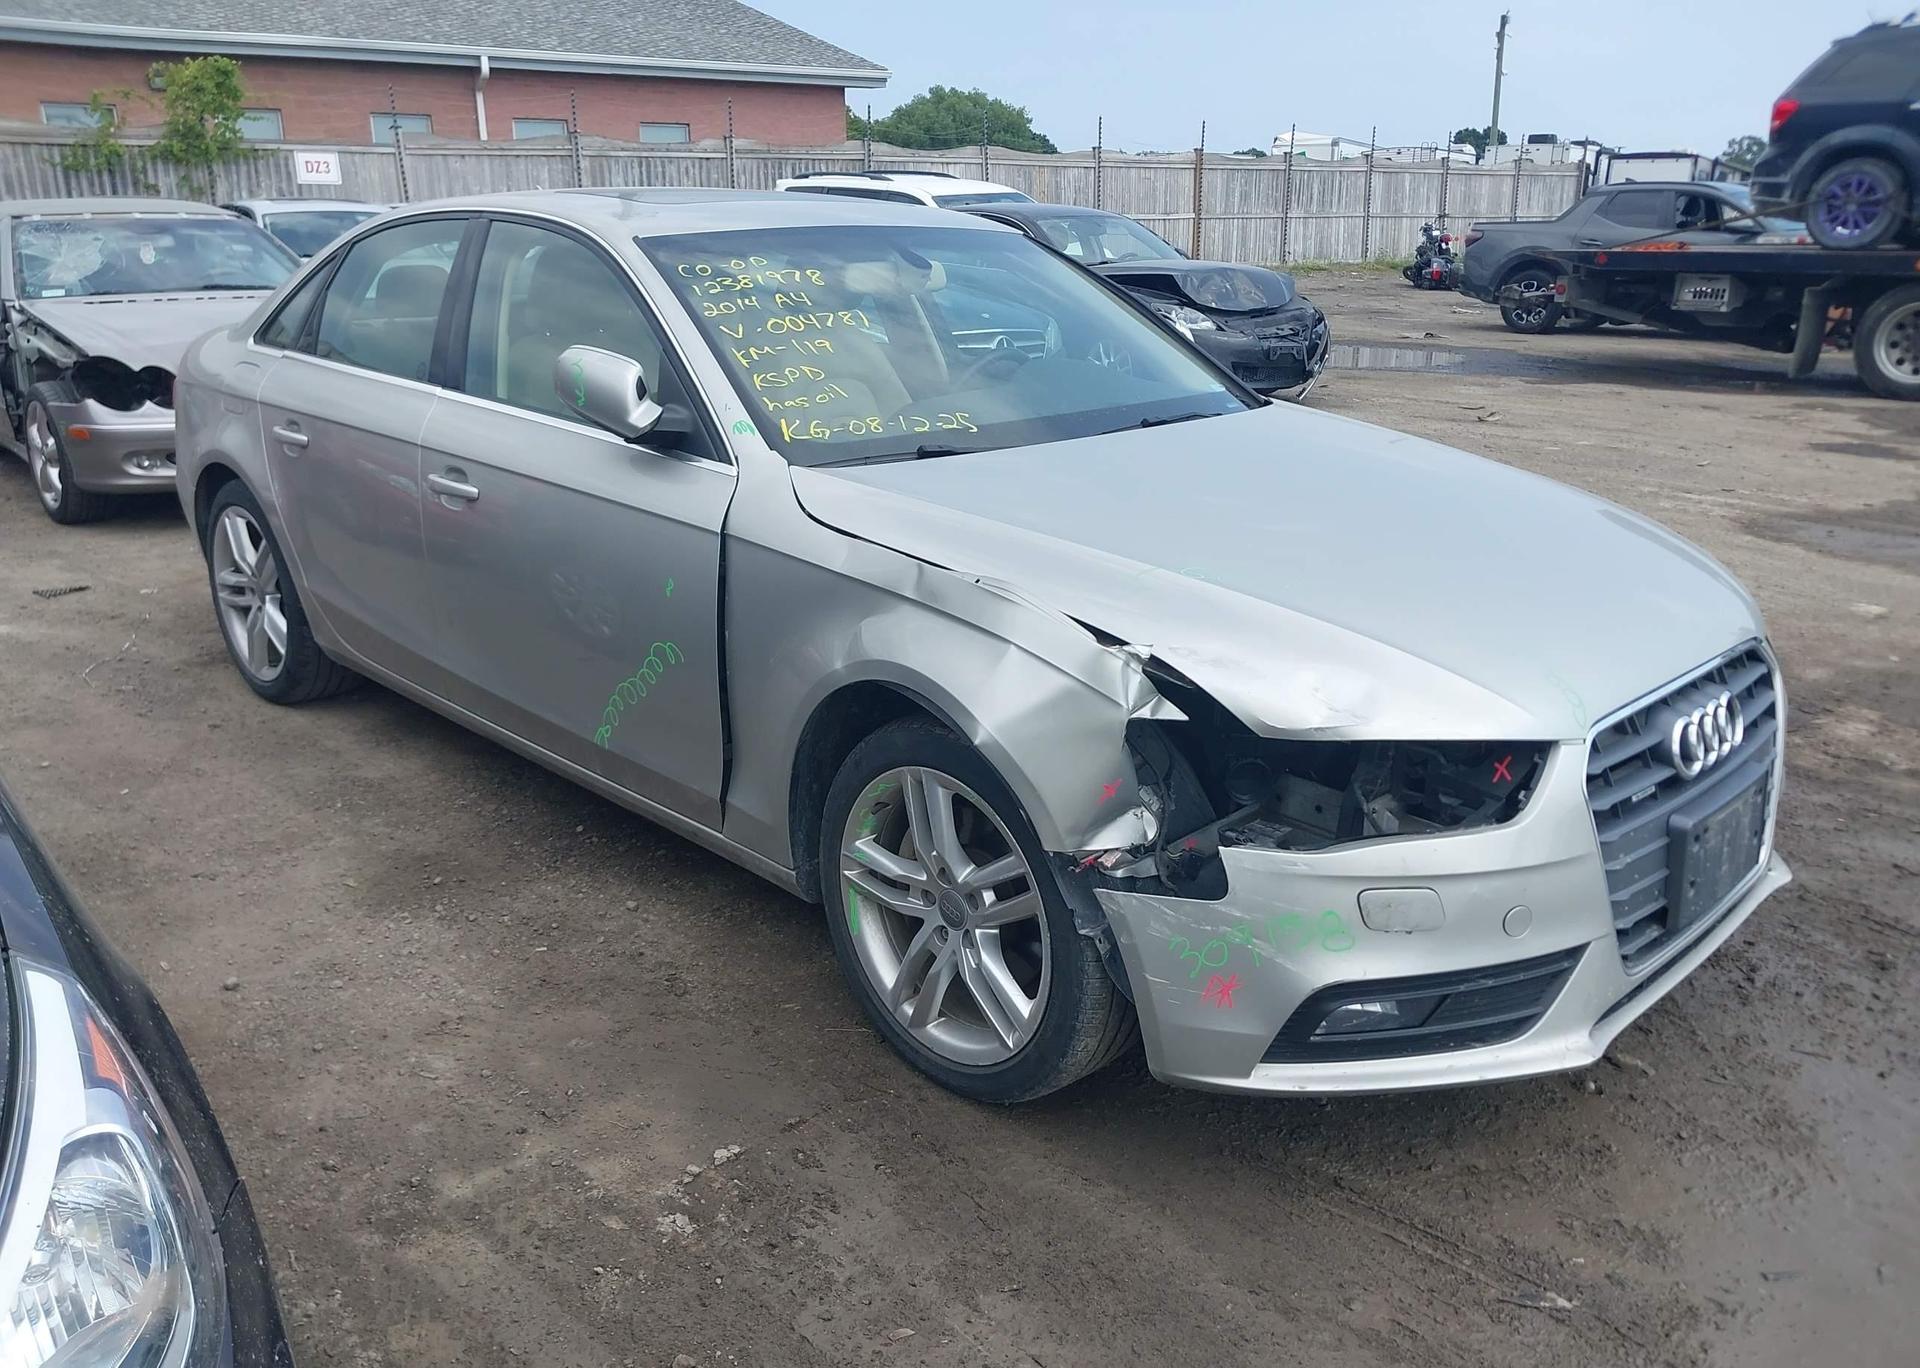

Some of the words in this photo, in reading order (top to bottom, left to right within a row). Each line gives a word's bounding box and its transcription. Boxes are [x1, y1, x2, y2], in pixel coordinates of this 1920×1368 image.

[304, 160, 331, 174] DZ3
[692, 269, 825, 296] 12381978
[703, 295, 761, 317] 2014
[775, 292, 813, 308] A4
